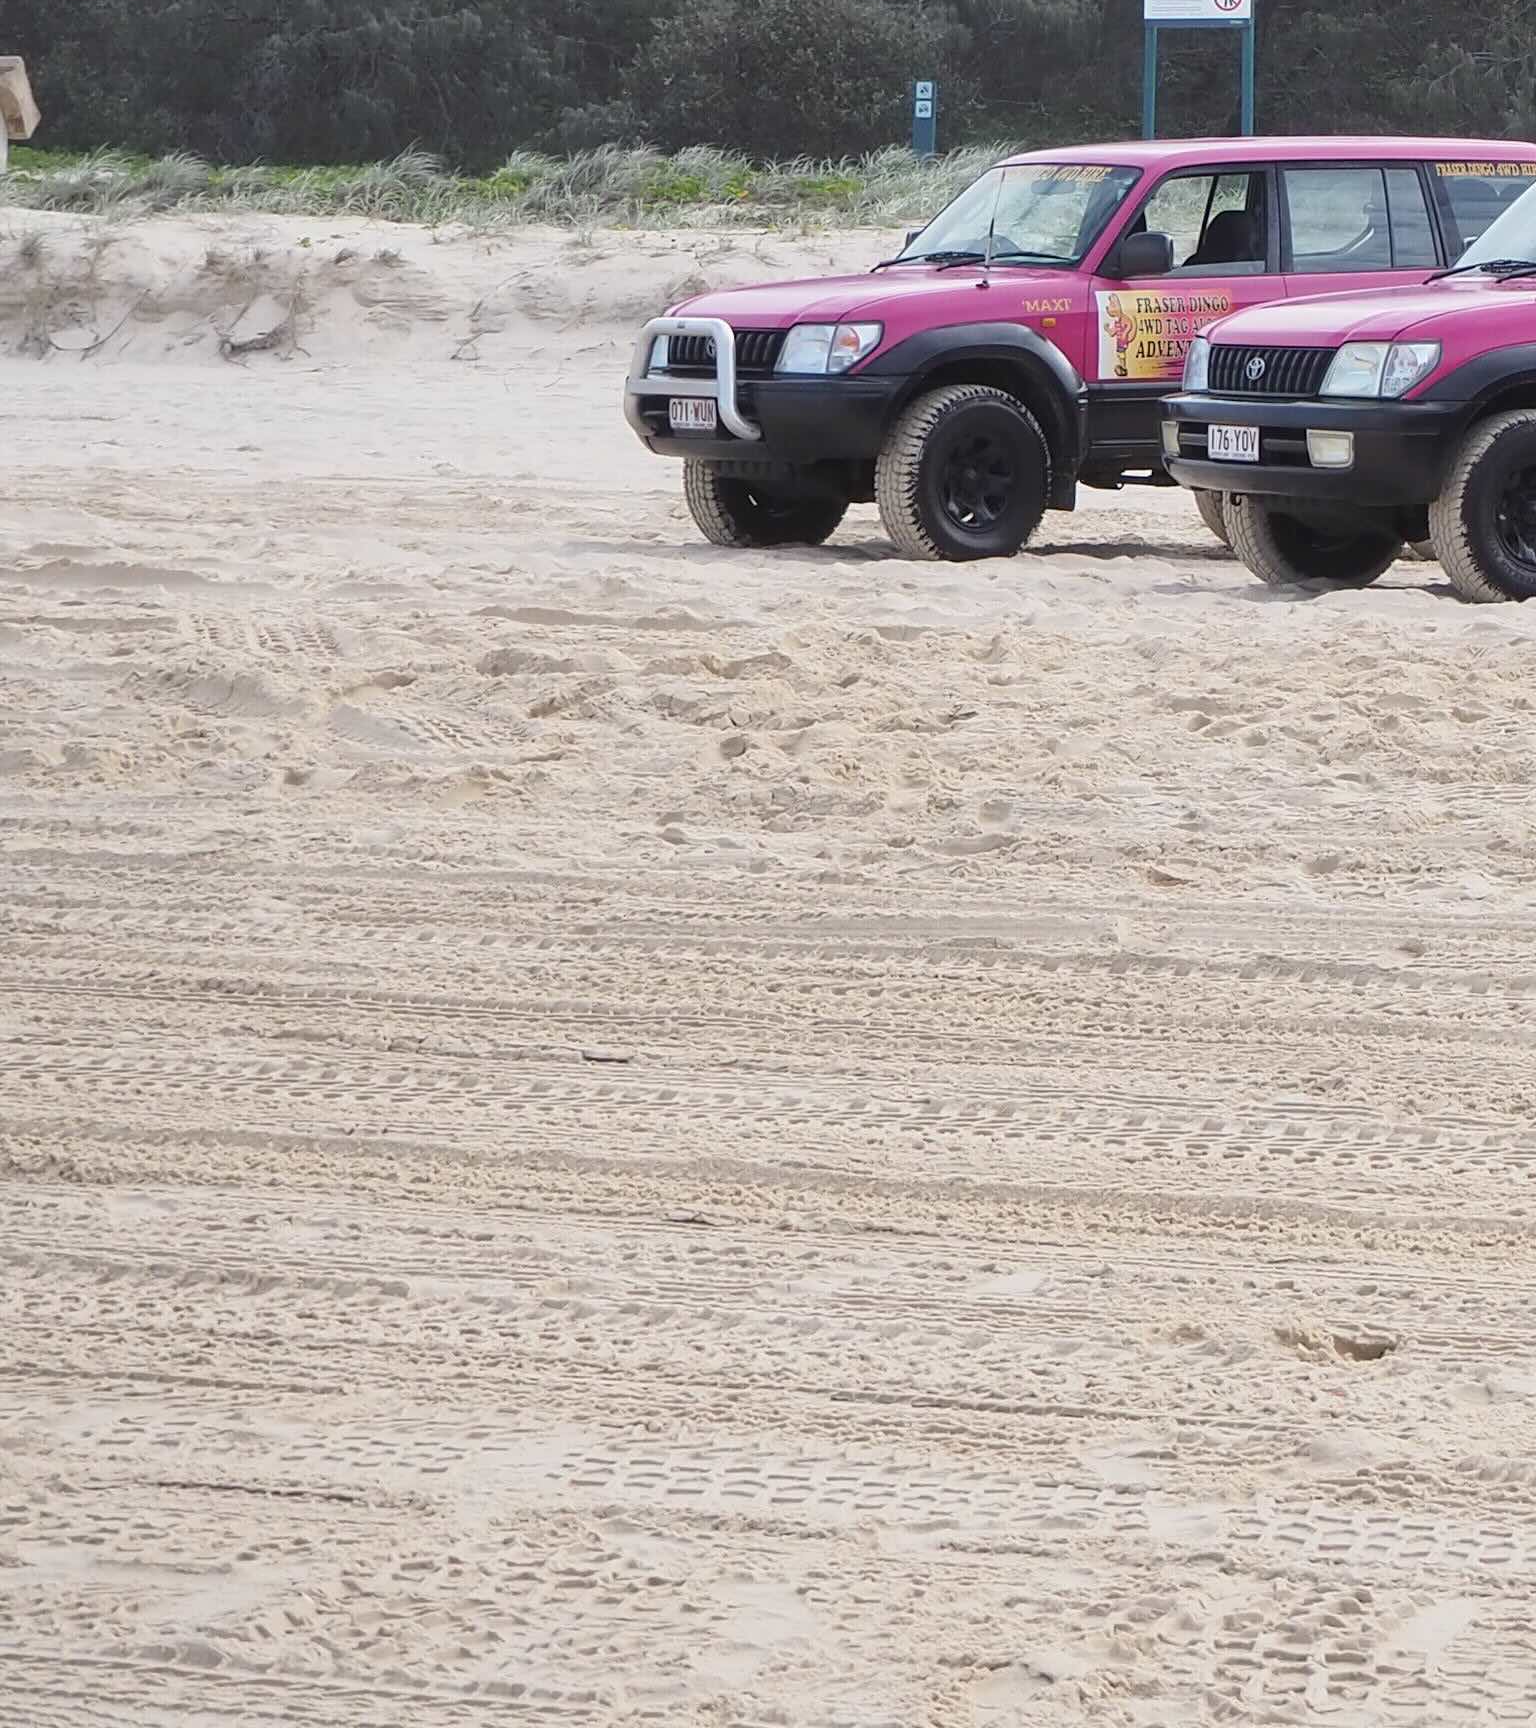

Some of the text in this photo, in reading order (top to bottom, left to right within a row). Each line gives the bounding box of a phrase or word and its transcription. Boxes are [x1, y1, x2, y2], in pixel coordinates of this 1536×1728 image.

[1136, 295, 1229, 313] FRASER DINGO
[1166, 318, 1188, 334] TAG
